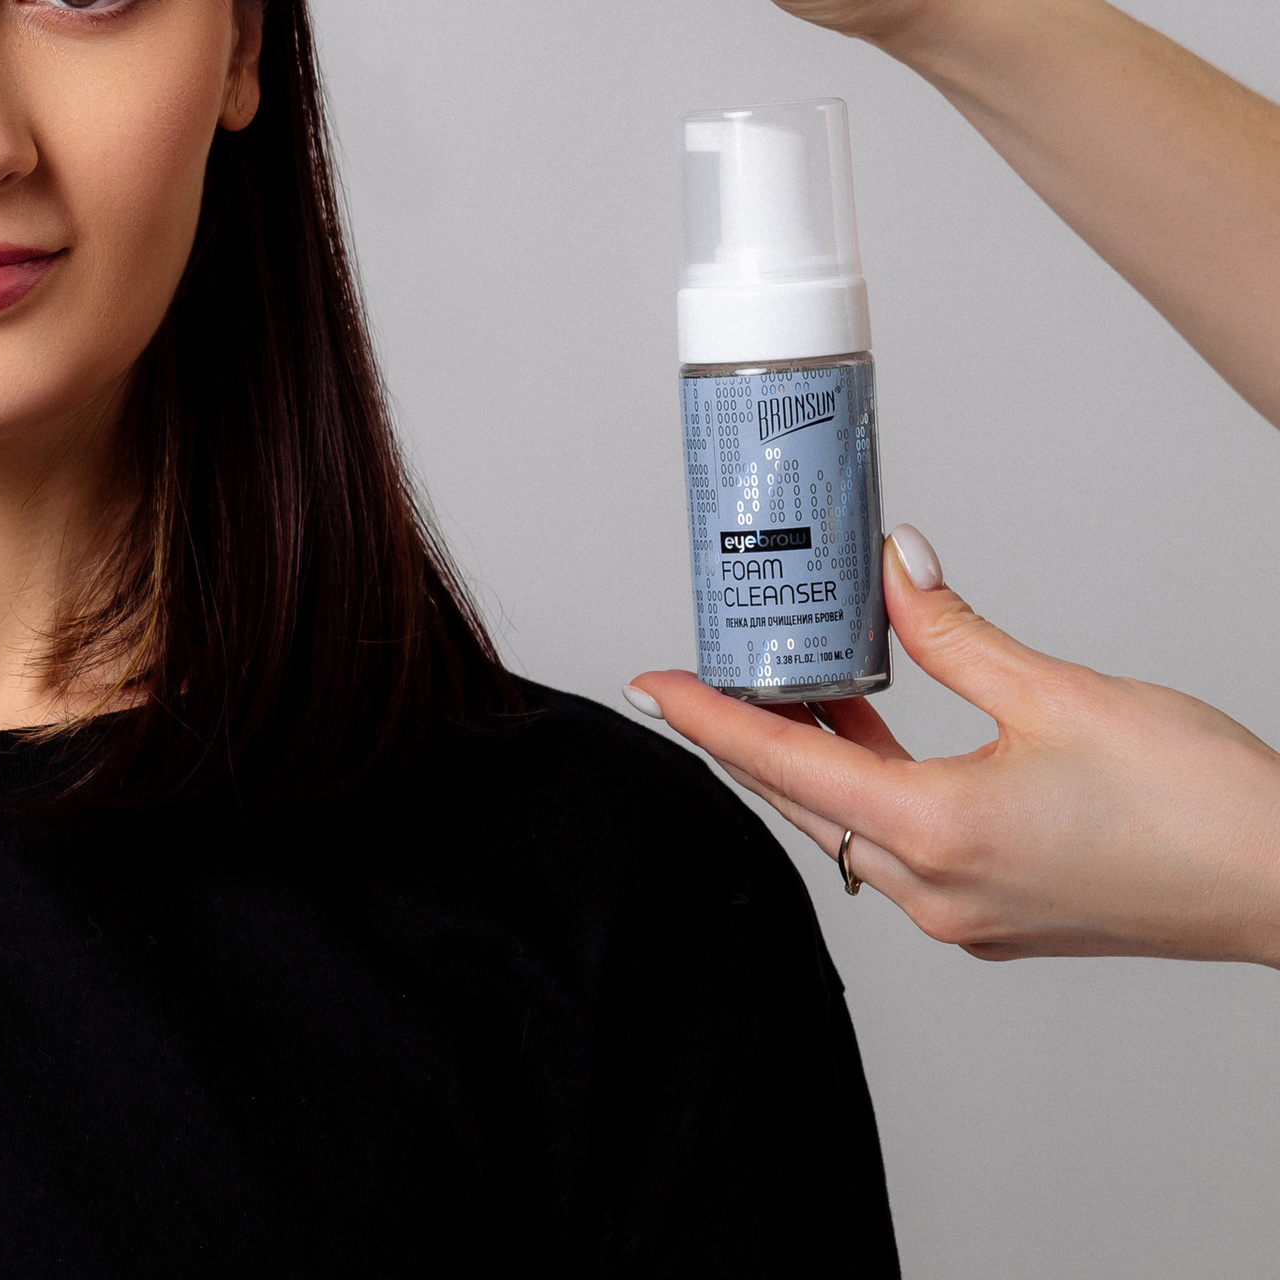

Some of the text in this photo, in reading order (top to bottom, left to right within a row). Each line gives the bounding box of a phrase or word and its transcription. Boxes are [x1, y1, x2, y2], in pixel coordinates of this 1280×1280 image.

[757, 390, 836, 441] BRONSUN
[724, 529, 807, 553] eyebrow
[721, 558, 784, 581] FOAM
[723, 580, 838, 608] CLEANSER
[725, 608, 844, 628] ПЕНКА ДЛЯ ОЧИЩЕНИЯ БРОВЕЙ
[776, 655, 794, 665] 3.38
[819, 651, 833, 662] 100
[834, 650, 845, 661] ML
